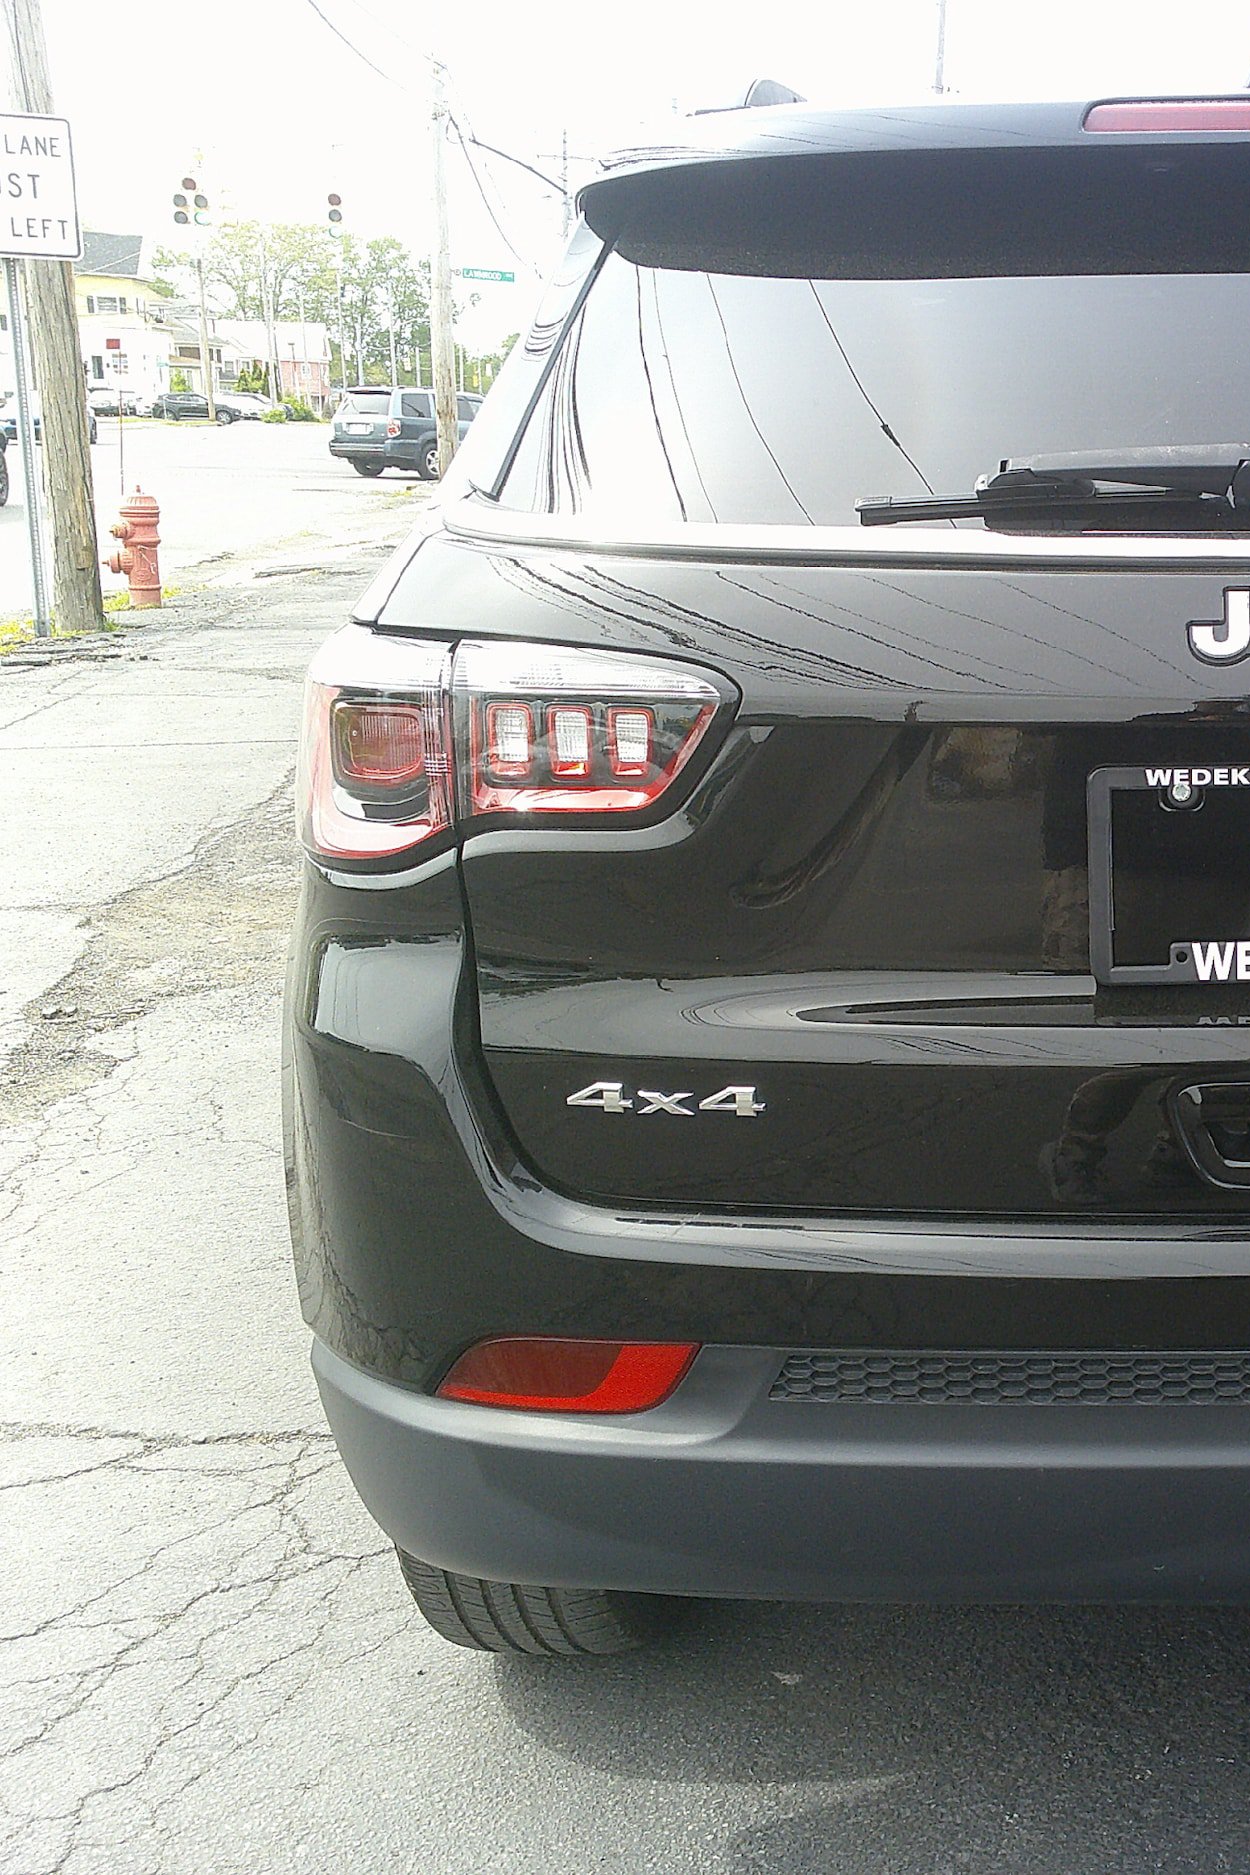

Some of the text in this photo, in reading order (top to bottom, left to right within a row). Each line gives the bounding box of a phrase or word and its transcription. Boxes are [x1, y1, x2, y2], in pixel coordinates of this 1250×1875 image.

[4, 134, 61, 157] LANE
[0, 172, 40, 199] ST
[10, 217, 68, 240] LEFT
[566, 1081, 767, 1117] 4x4
